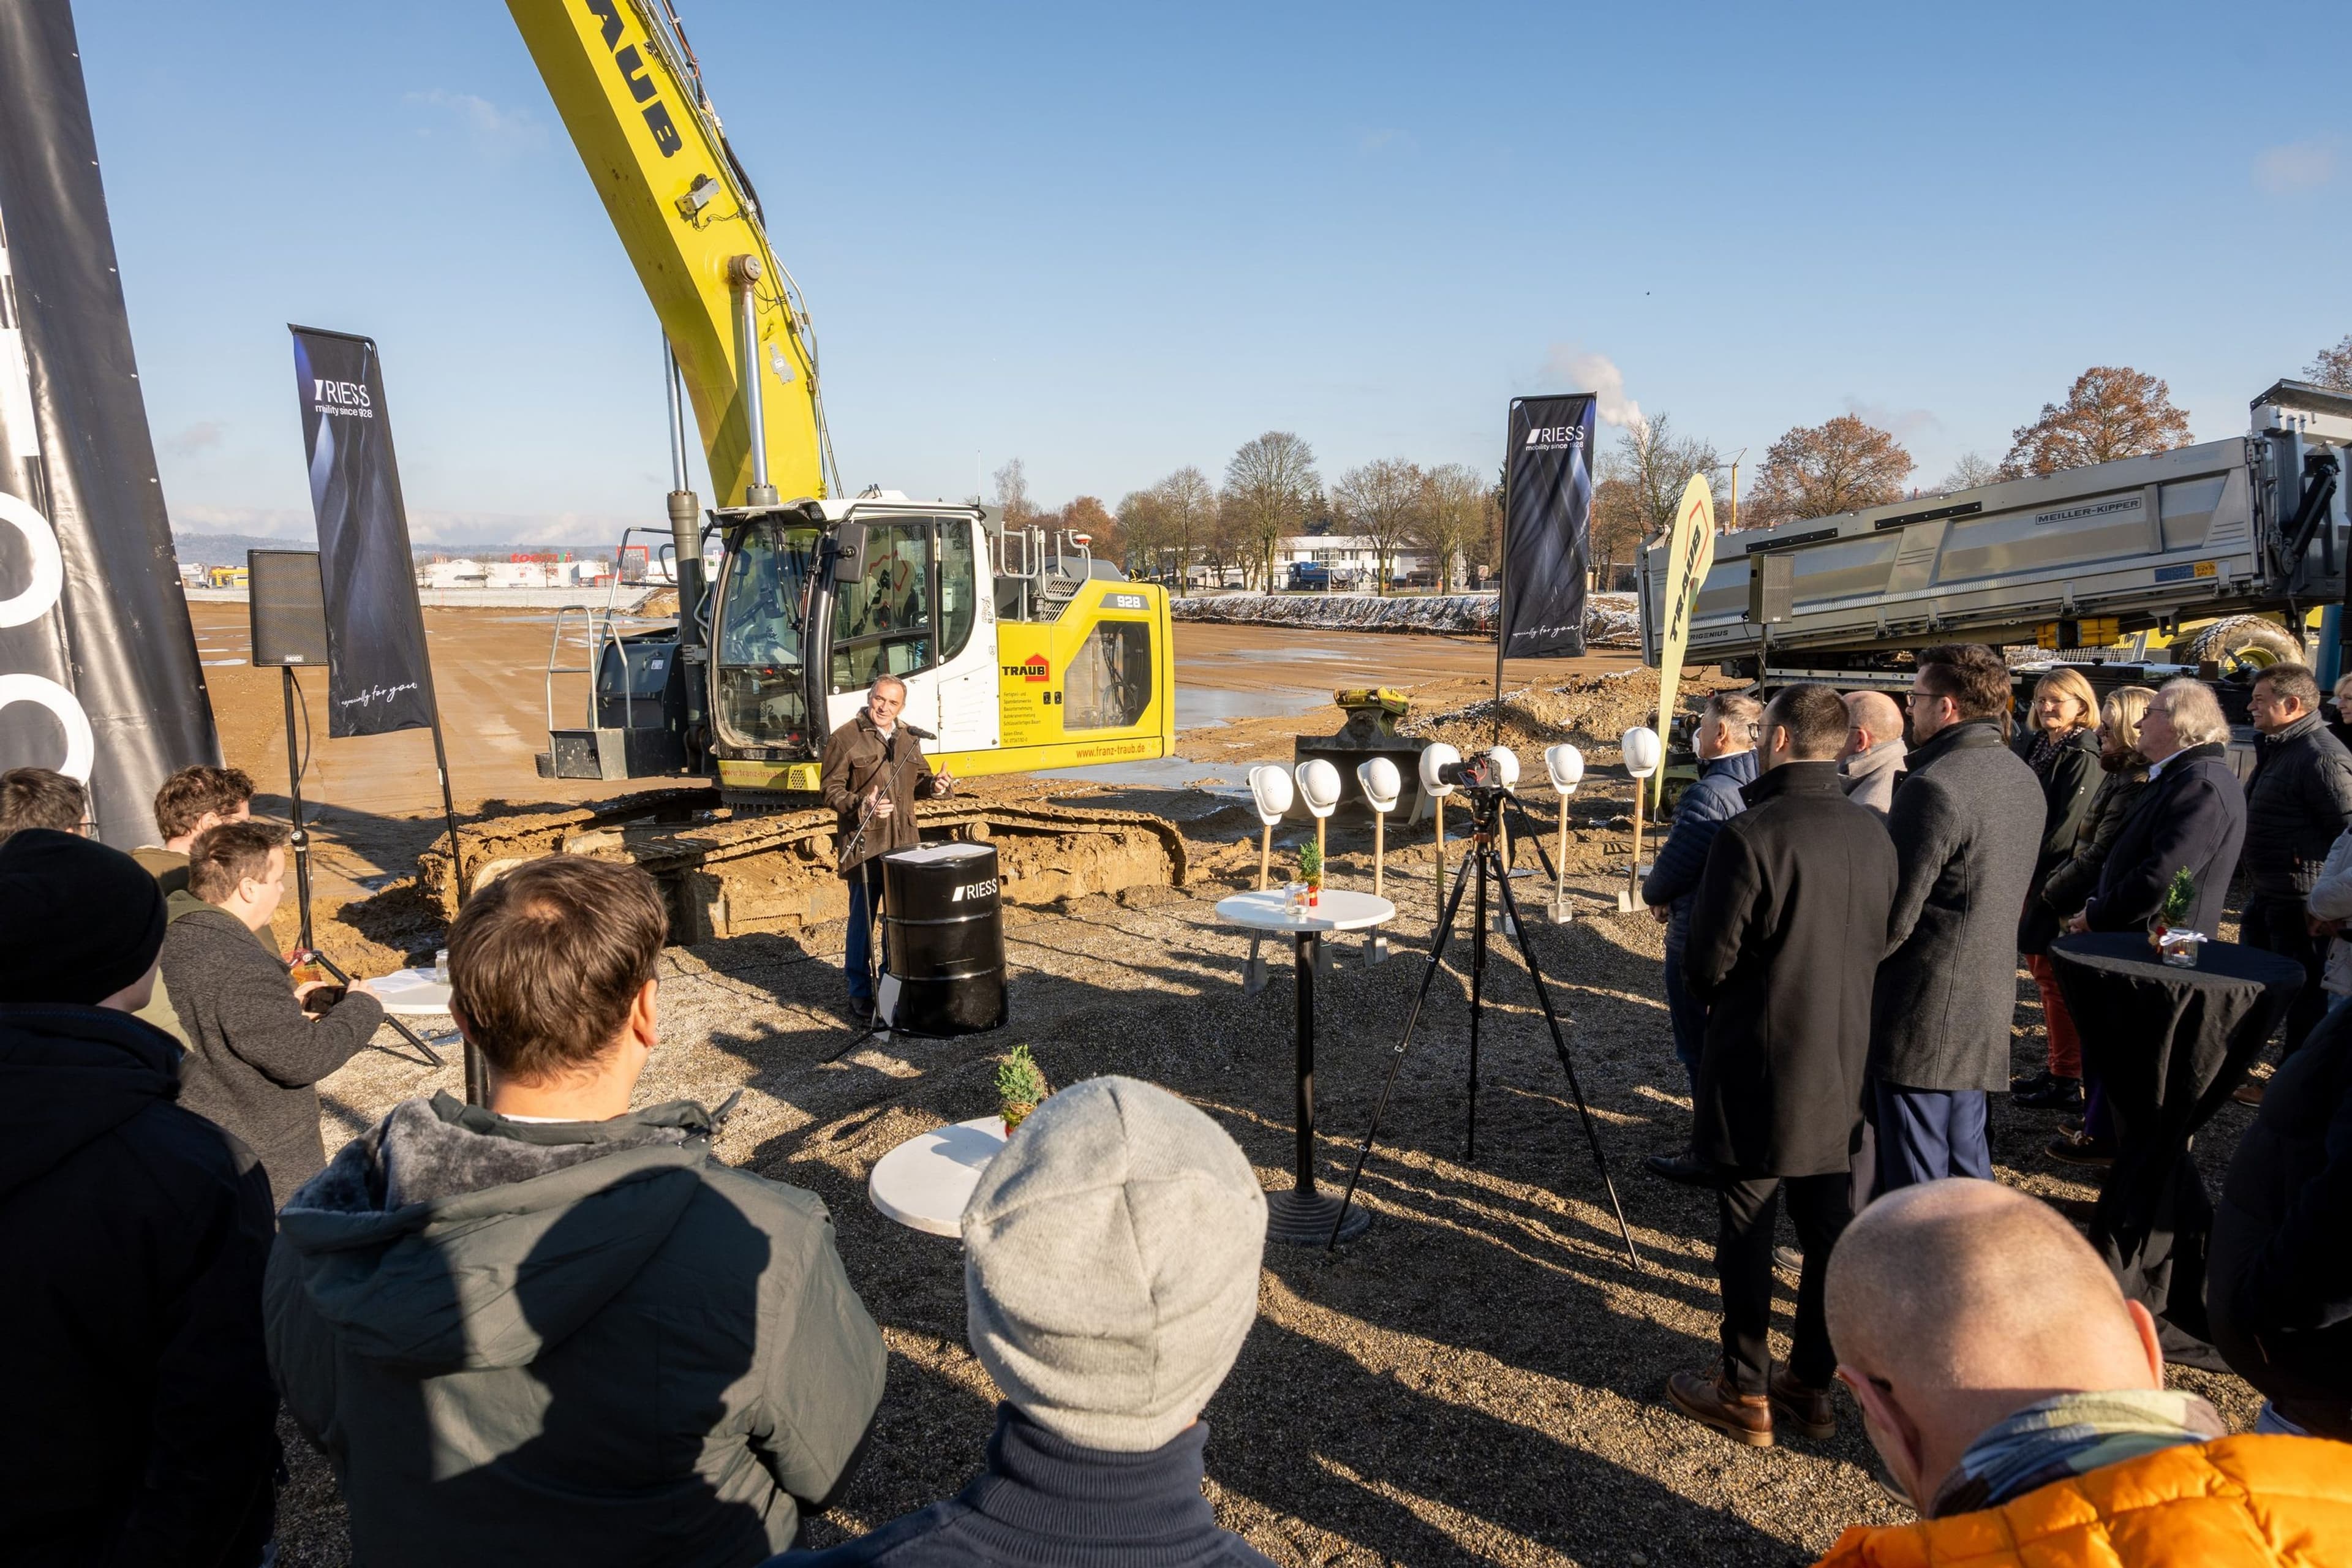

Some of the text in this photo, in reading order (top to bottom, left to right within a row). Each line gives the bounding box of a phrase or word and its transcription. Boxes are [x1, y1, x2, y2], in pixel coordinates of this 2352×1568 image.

[325, 380, 371, 407] RIESS
[1541, 425, 1584, 442] RIESS
[1526, 442, 1550, 451] mobility
[2038, 500, 2139, 522] MEILLER-KIPPER
[1670, 524, 1701, 643] TRAUB
[1117, 595, 1141, 608] 928
[1550, 625, 1580, 638] you
[1689, 630, 1728, 640] RIGENIUS
[1001, 666, 1045, 676] TRAUB
[372, 684, 387, 701] for
[386, 682, 417, 703] you
[1076, 743, 1145, 758] www.franz-traub.de
[967, 878, 997, 900] RIESS
